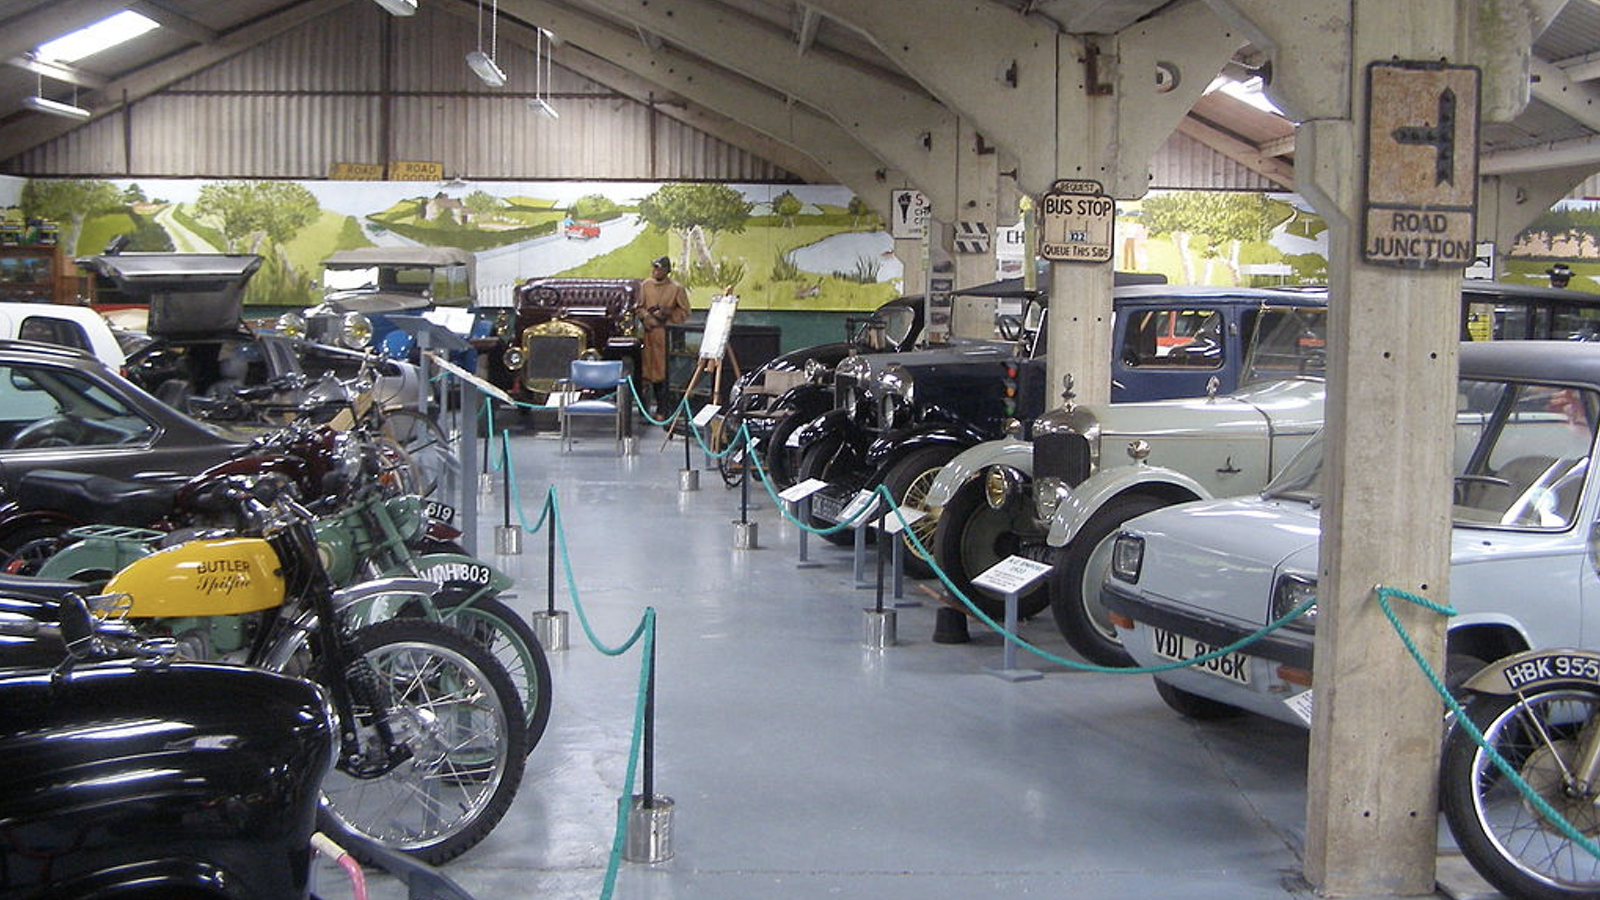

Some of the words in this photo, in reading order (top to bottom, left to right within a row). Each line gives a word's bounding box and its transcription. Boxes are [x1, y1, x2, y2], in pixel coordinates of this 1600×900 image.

[406, 163, 437, 175] ROAD
[1060, 182, 1094, 192] REQUEST
[1046, 199, 1073, 215] BUS
[1077, 199, 1112, 217] STOP
[1392, 212, 1447, 233] ROAD
[1044, 244, 1070, 256] QUEUE
[1073, 245, 1090, 257] THIS
[1092, 246, 1109, 259] SIDE
[1366, 237, 1471, 260] JUNCTION
[197, 560, 250, 575] BUTLER
[460, 564, 490, 585] 803
[1154, 628, 1188, 662] VDL
[1505, 657, 1554, 688] HBK
[1555, 656, 1600, 678] 955
